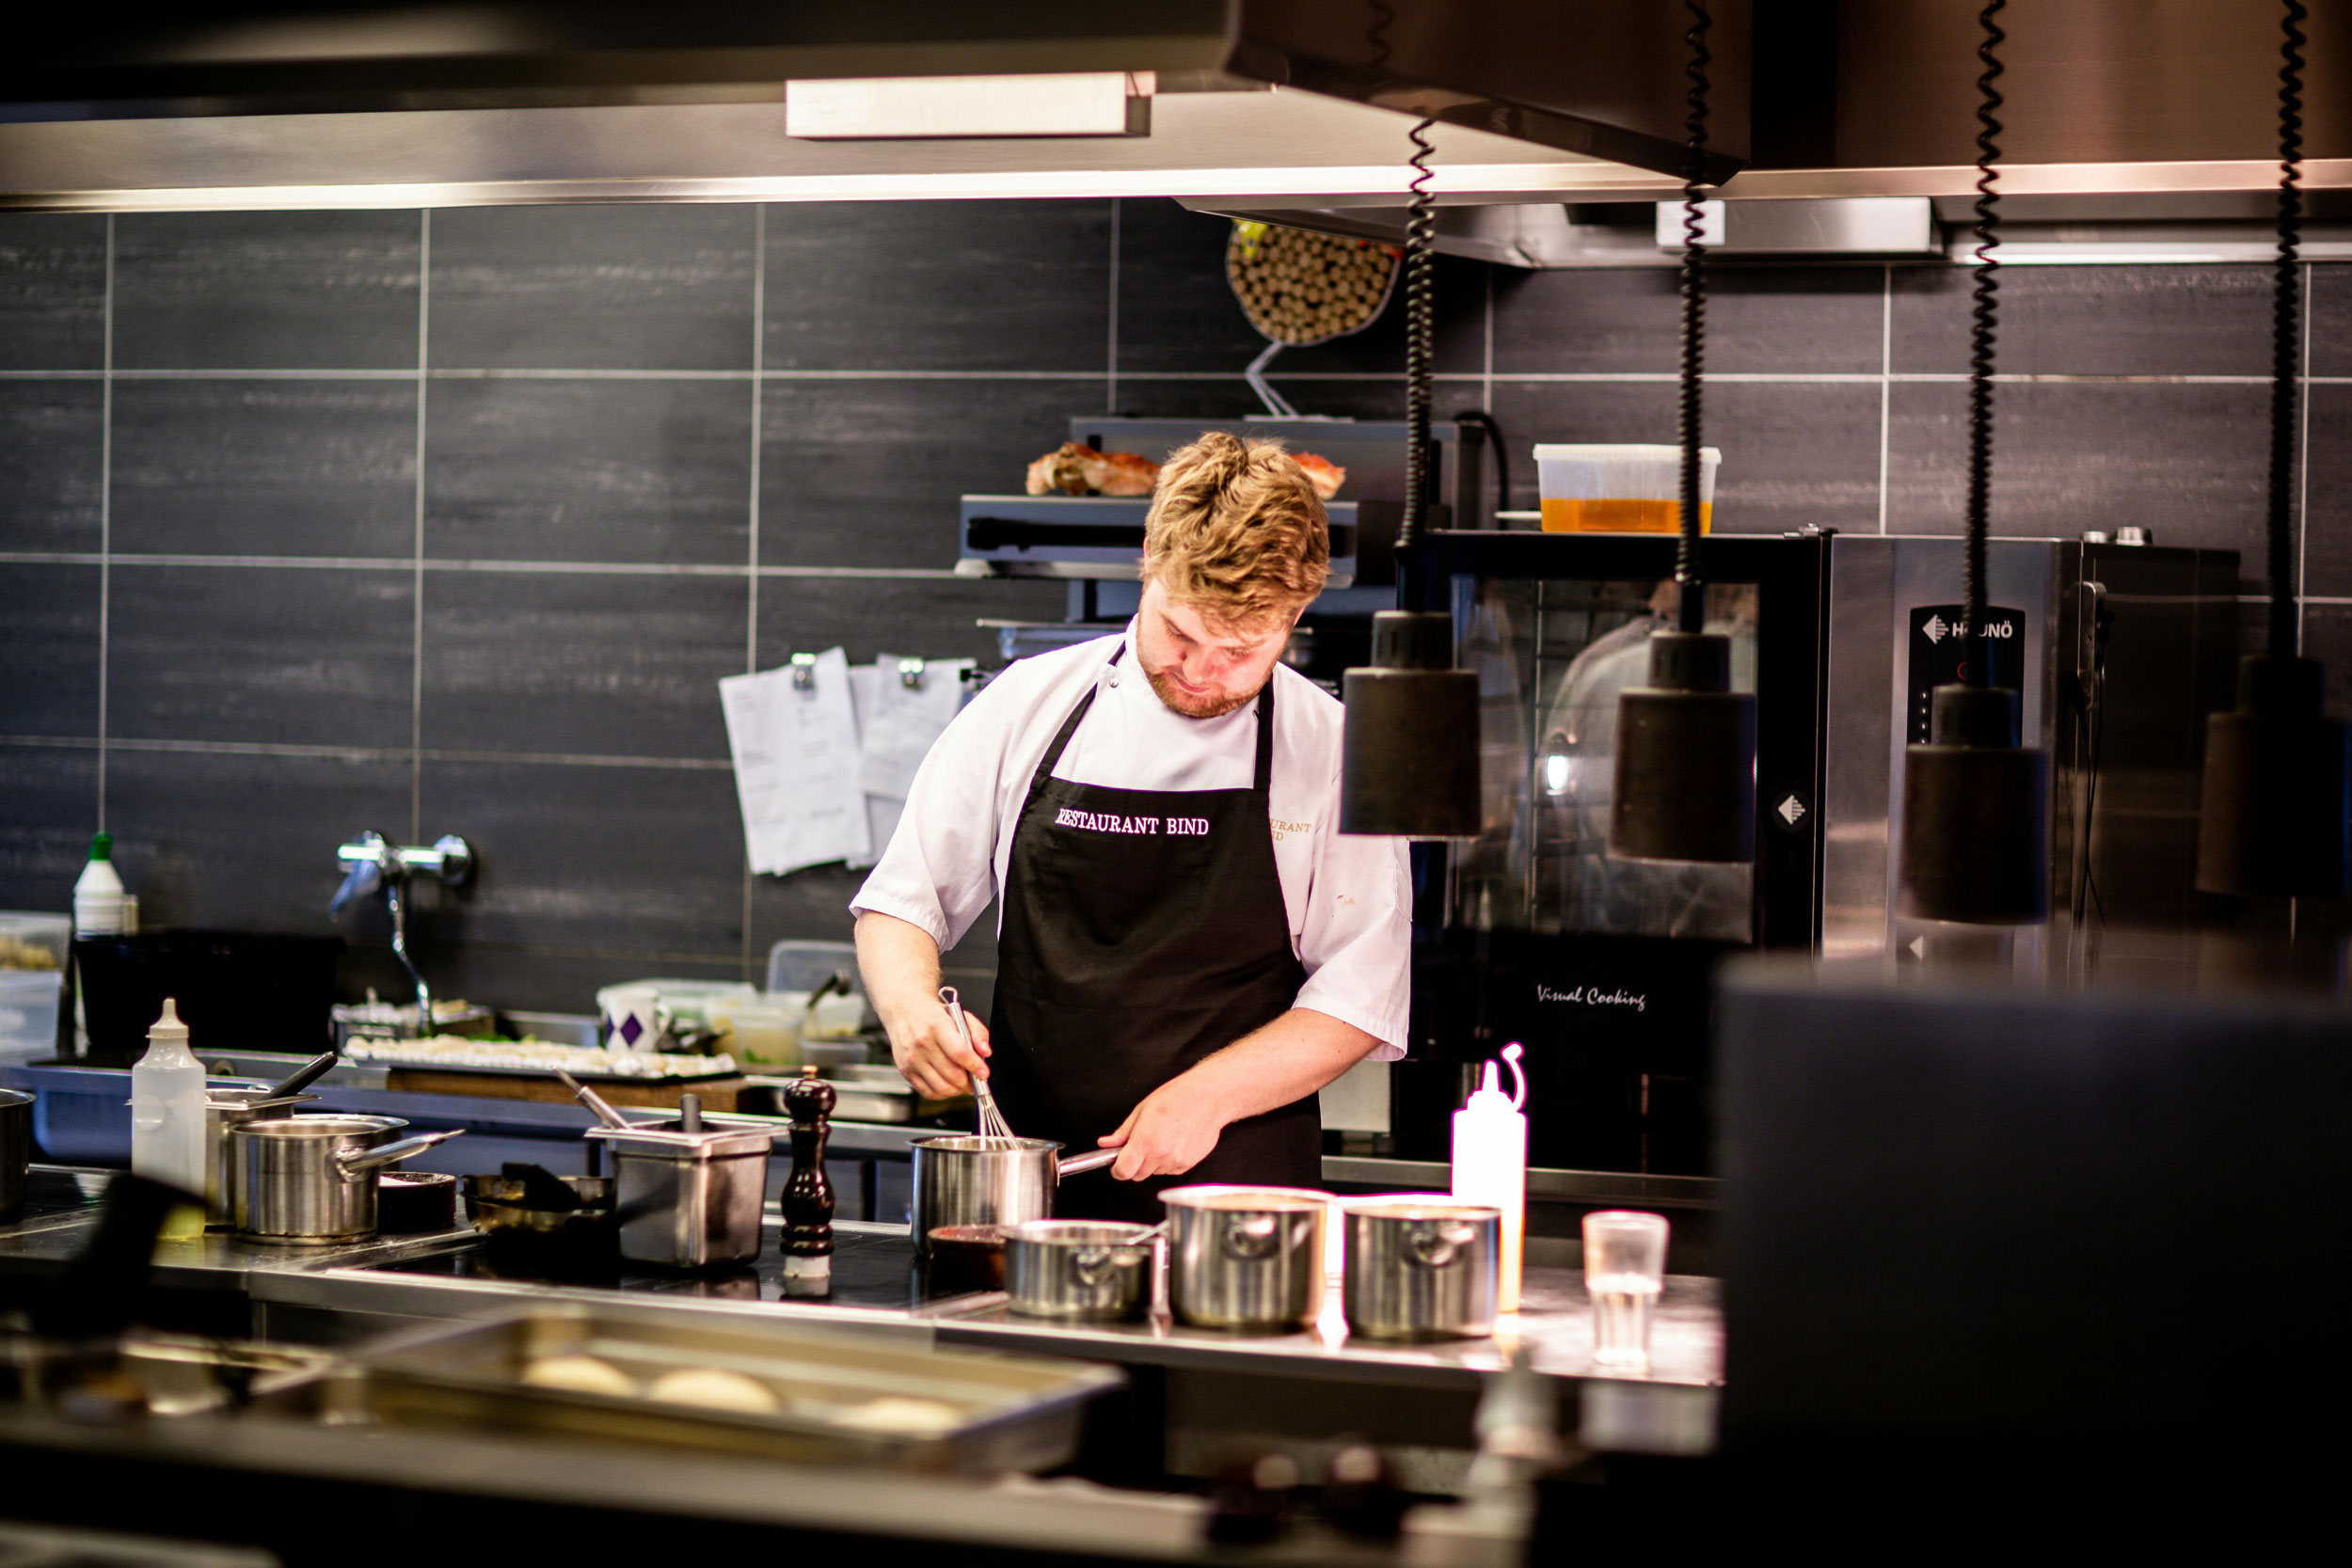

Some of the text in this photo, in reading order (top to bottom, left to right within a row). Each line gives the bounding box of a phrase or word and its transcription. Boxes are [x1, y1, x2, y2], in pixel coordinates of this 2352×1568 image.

[1952, 620, 2012, 638] HUNÖ
[1055, 808, 1209, 835] RESTAURANT BIND
[1270, 818, 1311, 832] URANT
[1537, 984, 1646, 1012] Visual Cooking
